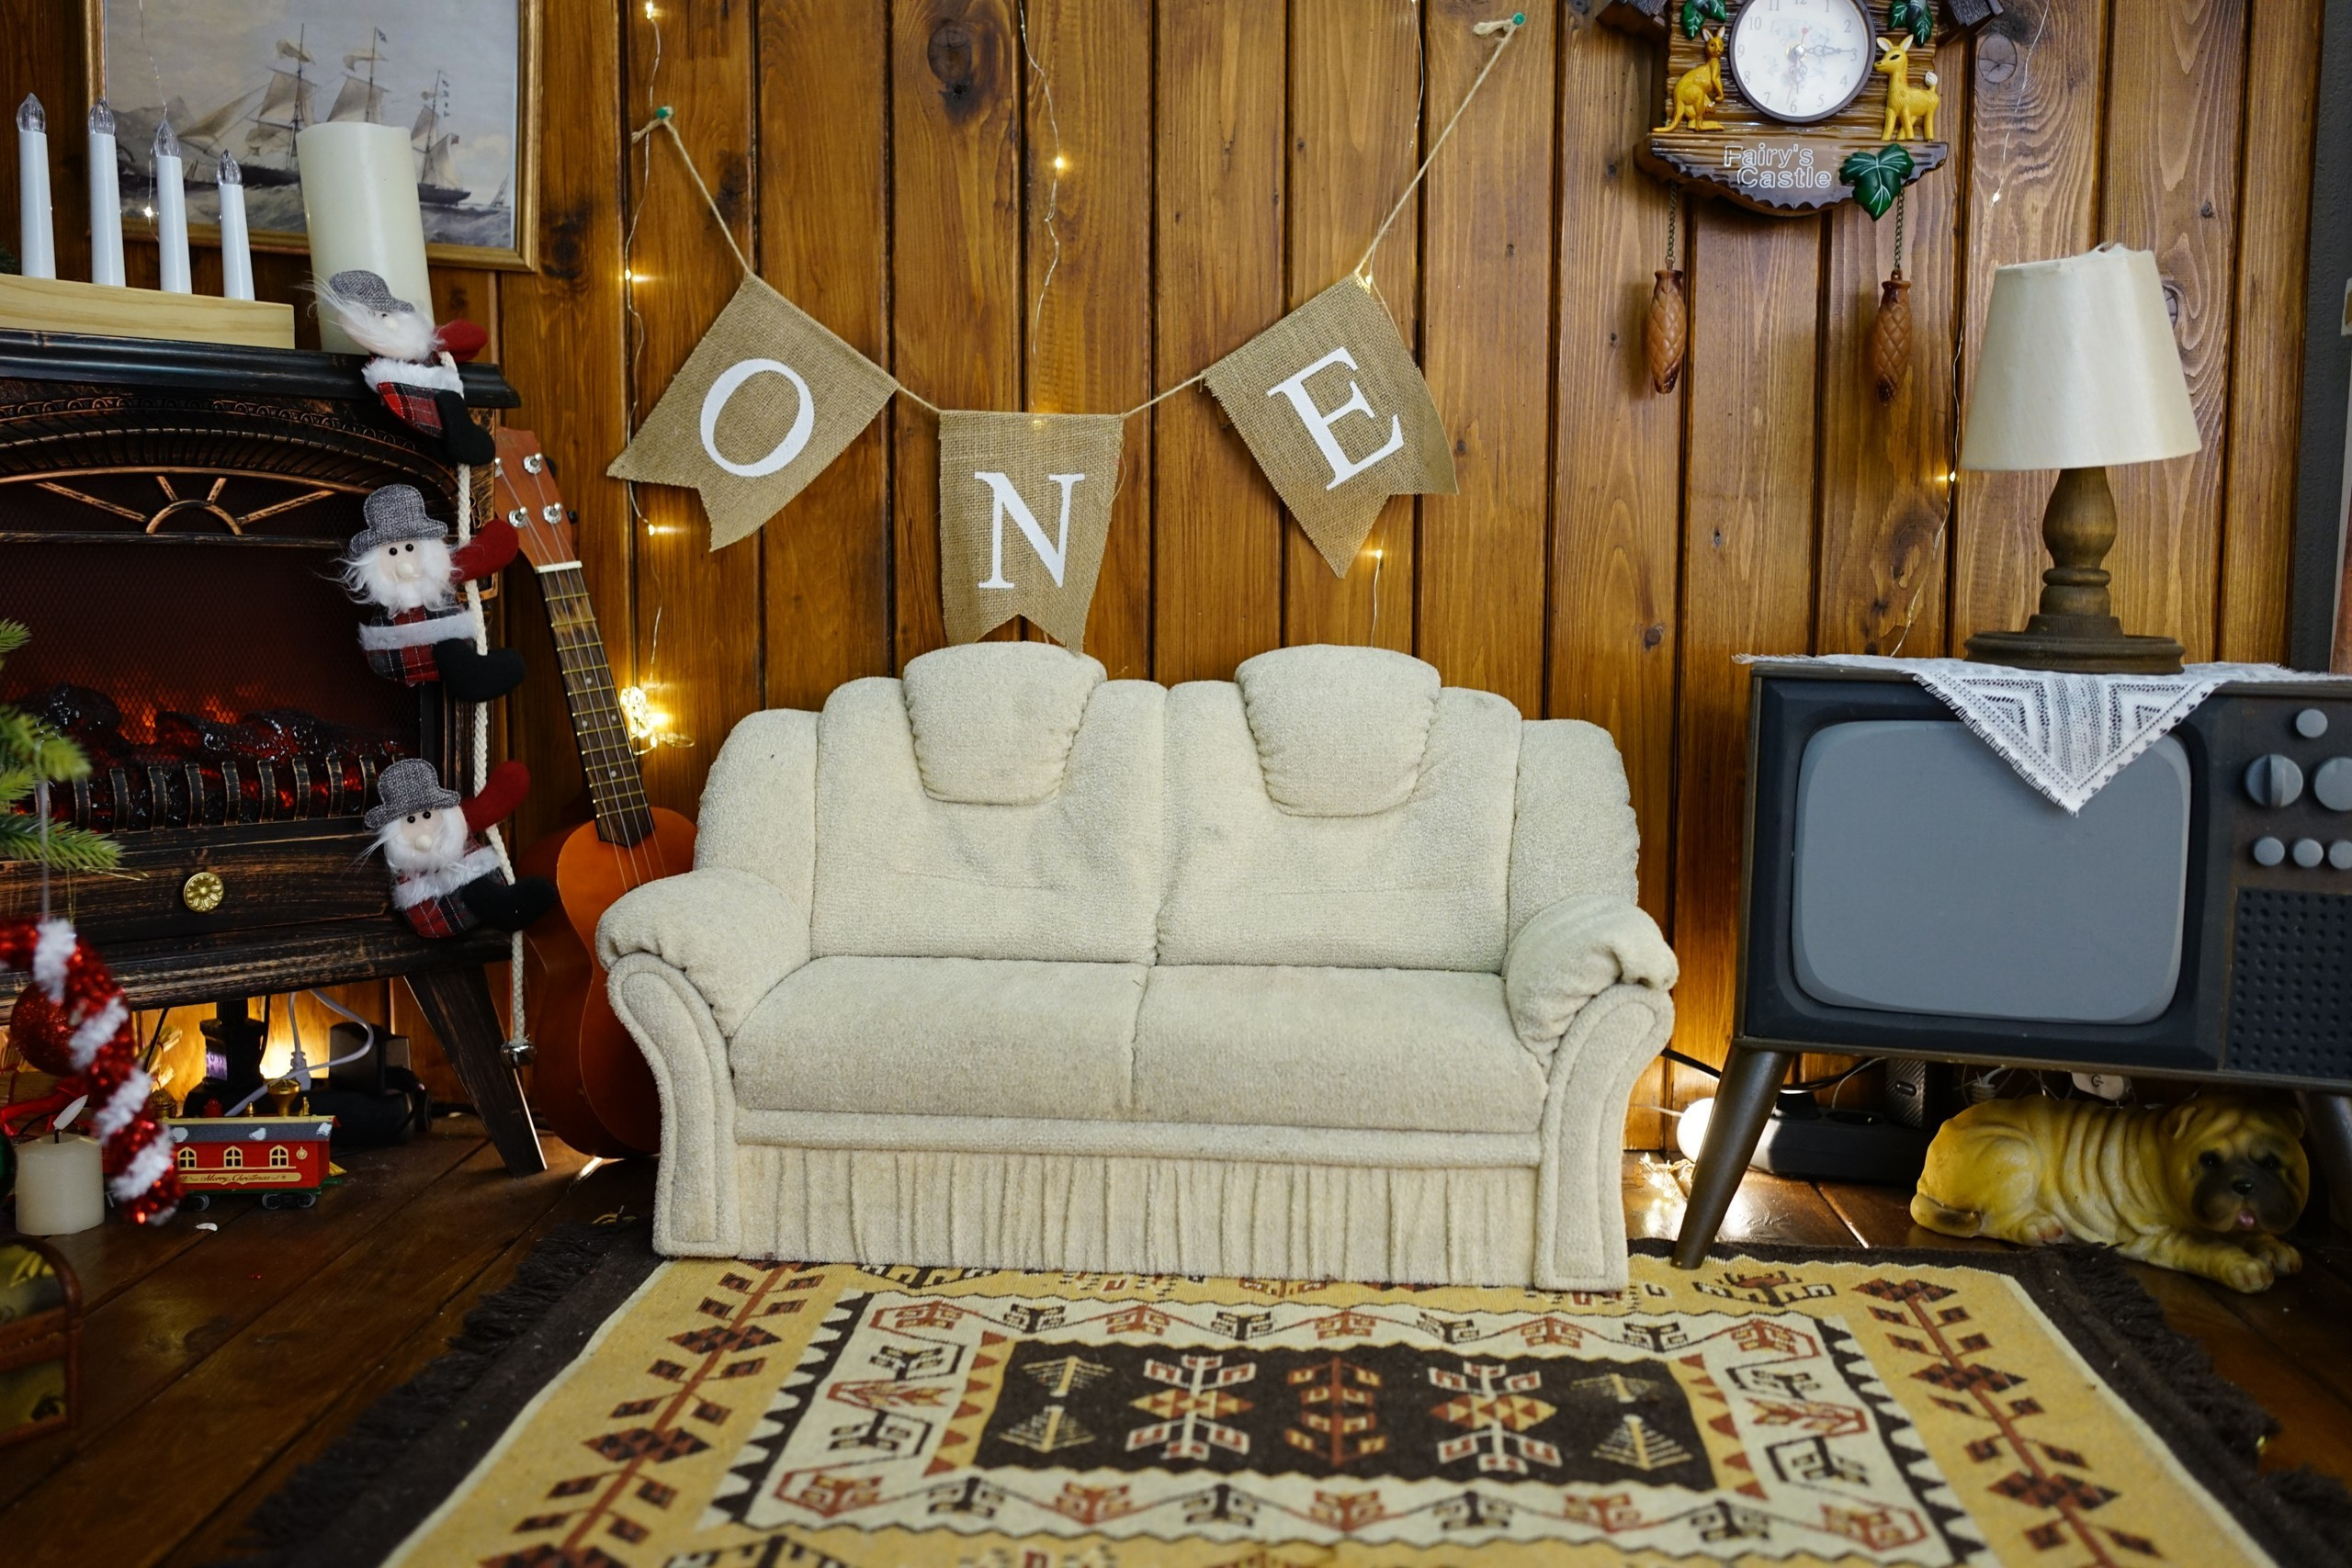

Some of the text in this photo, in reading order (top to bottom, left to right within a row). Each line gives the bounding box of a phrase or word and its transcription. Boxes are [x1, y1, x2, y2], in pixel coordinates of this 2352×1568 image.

[1768, 0, 1781, 11] 11
[1825, 0, 1830, 12] 1
[1749, 17, 1762, 30] 10
[1844, 19, 1851, 33] 2
[1737, 44, 1746, 58] 9
[1849, 47, 1858, 62] 3
[1744, 71, 1751, 85] 8
[1839, 73, 1849, 87] 4
[1764, 92, 1771, 106] 7
[1816, 94, 1825, 107] 5
[1790, 100, 1797, 113] 6
[1724, 142, 1814, 168] Fairy's
[1736, 165, 1832, 188] Castle
[201, 1174, 270, 1183] Merry Christmas
